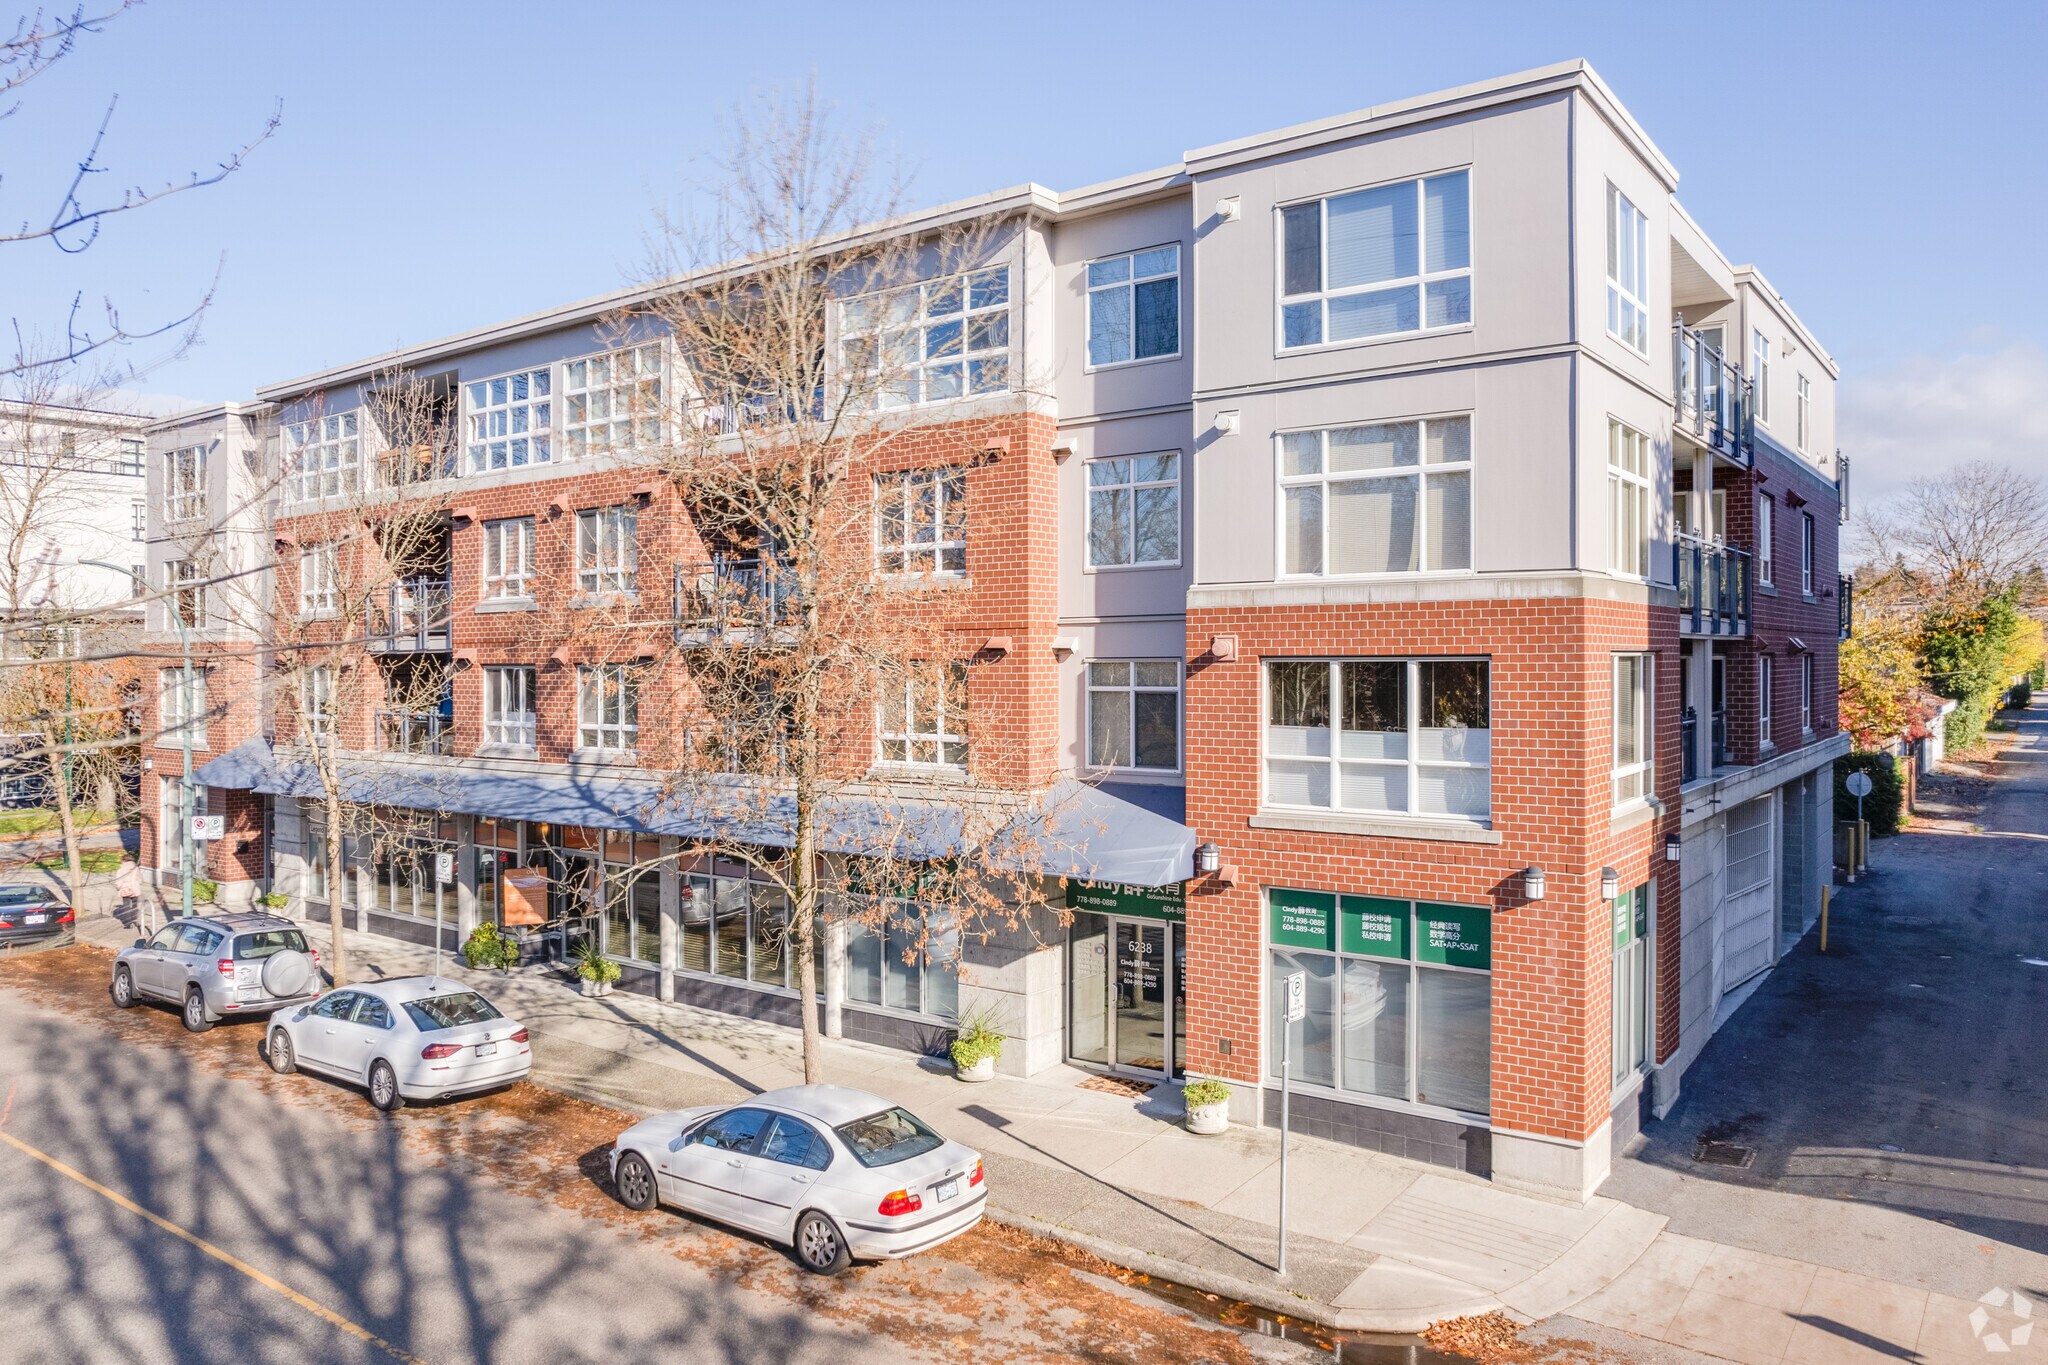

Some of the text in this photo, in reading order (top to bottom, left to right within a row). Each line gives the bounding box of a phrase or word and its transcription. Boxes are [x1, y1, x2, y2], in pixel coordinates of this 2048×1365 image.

[1076, 895, 1117, 907] 778-898-0889
[1282, 915, 1325, 927] 778-898-0889
[1282, 923, 1325, 935] 604-889-4290
